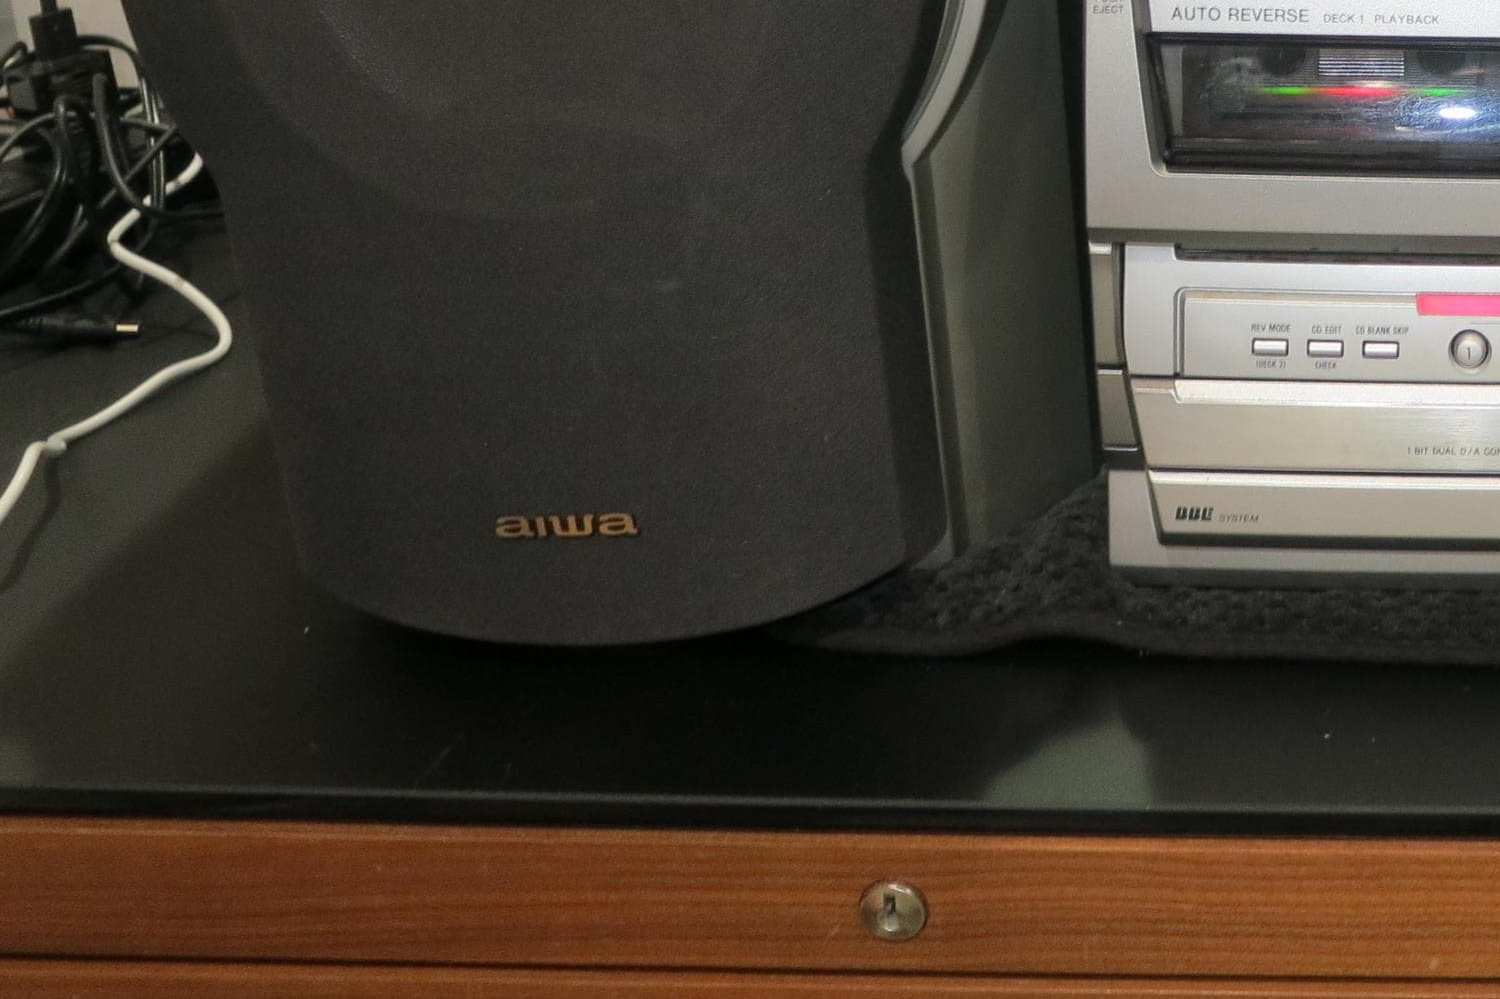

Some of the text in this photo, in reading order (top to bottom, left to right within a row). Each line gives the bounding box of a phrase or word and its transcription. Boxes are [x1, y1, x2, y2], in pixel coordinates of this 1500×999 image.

[1092, 4, 1124, 15] EJECT
[1171, 6, 1222, 22] AUTO
[1227, 7, 1311, 23] REVERSE
[1323, 13, 1357, 25] DECK
[1374, 14, 1441, 26] PLAYBACK
[1268, 323, 1291, 334] MODE
[1324, 325, 1343, 335] EDIT
[1366, 326, 1391, 336] BLANK
[1314, 361, 1338, 371] CHECK
[1414, 446, 1429, 456] BIT
[1432, 446, 1458, 456] DUAL
[495, 512, 638, 538] aiwa
